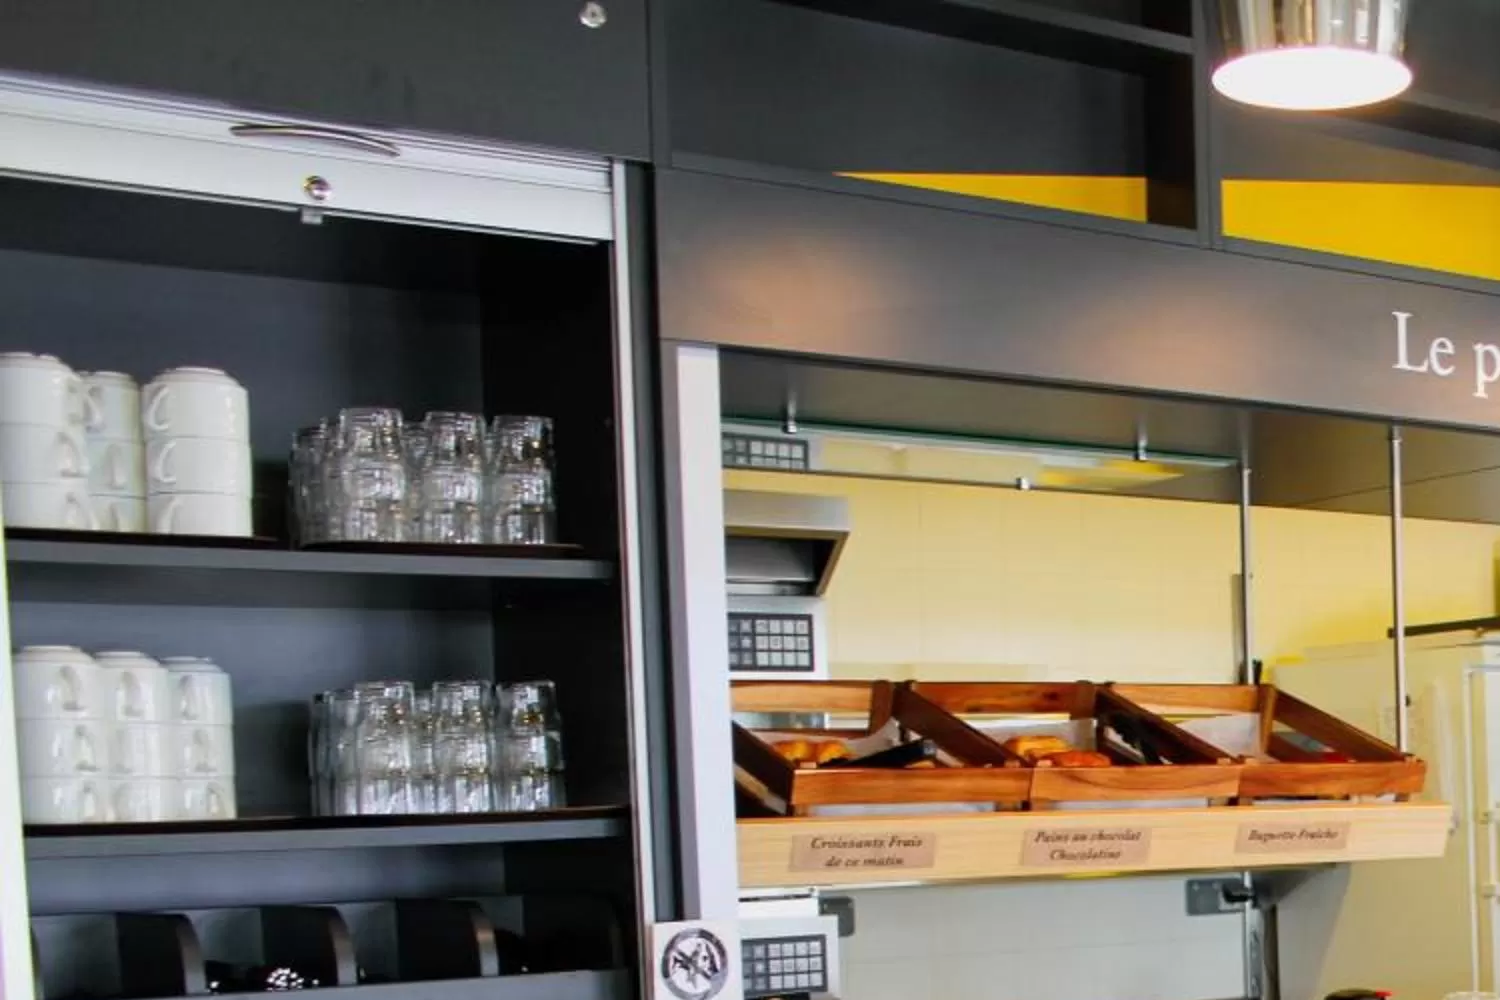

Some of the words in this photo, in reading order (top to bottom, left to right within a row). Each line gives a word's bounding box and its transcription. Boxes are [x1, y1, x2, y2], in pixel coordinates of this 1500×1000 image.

[1392, 311, 1455, 377] Le
[810, 835, 886, 849] Croissants
[887, 834, 924, 848] Frais
[824, 855, 842, 868] de
[863, 854, 905, 867] matin
